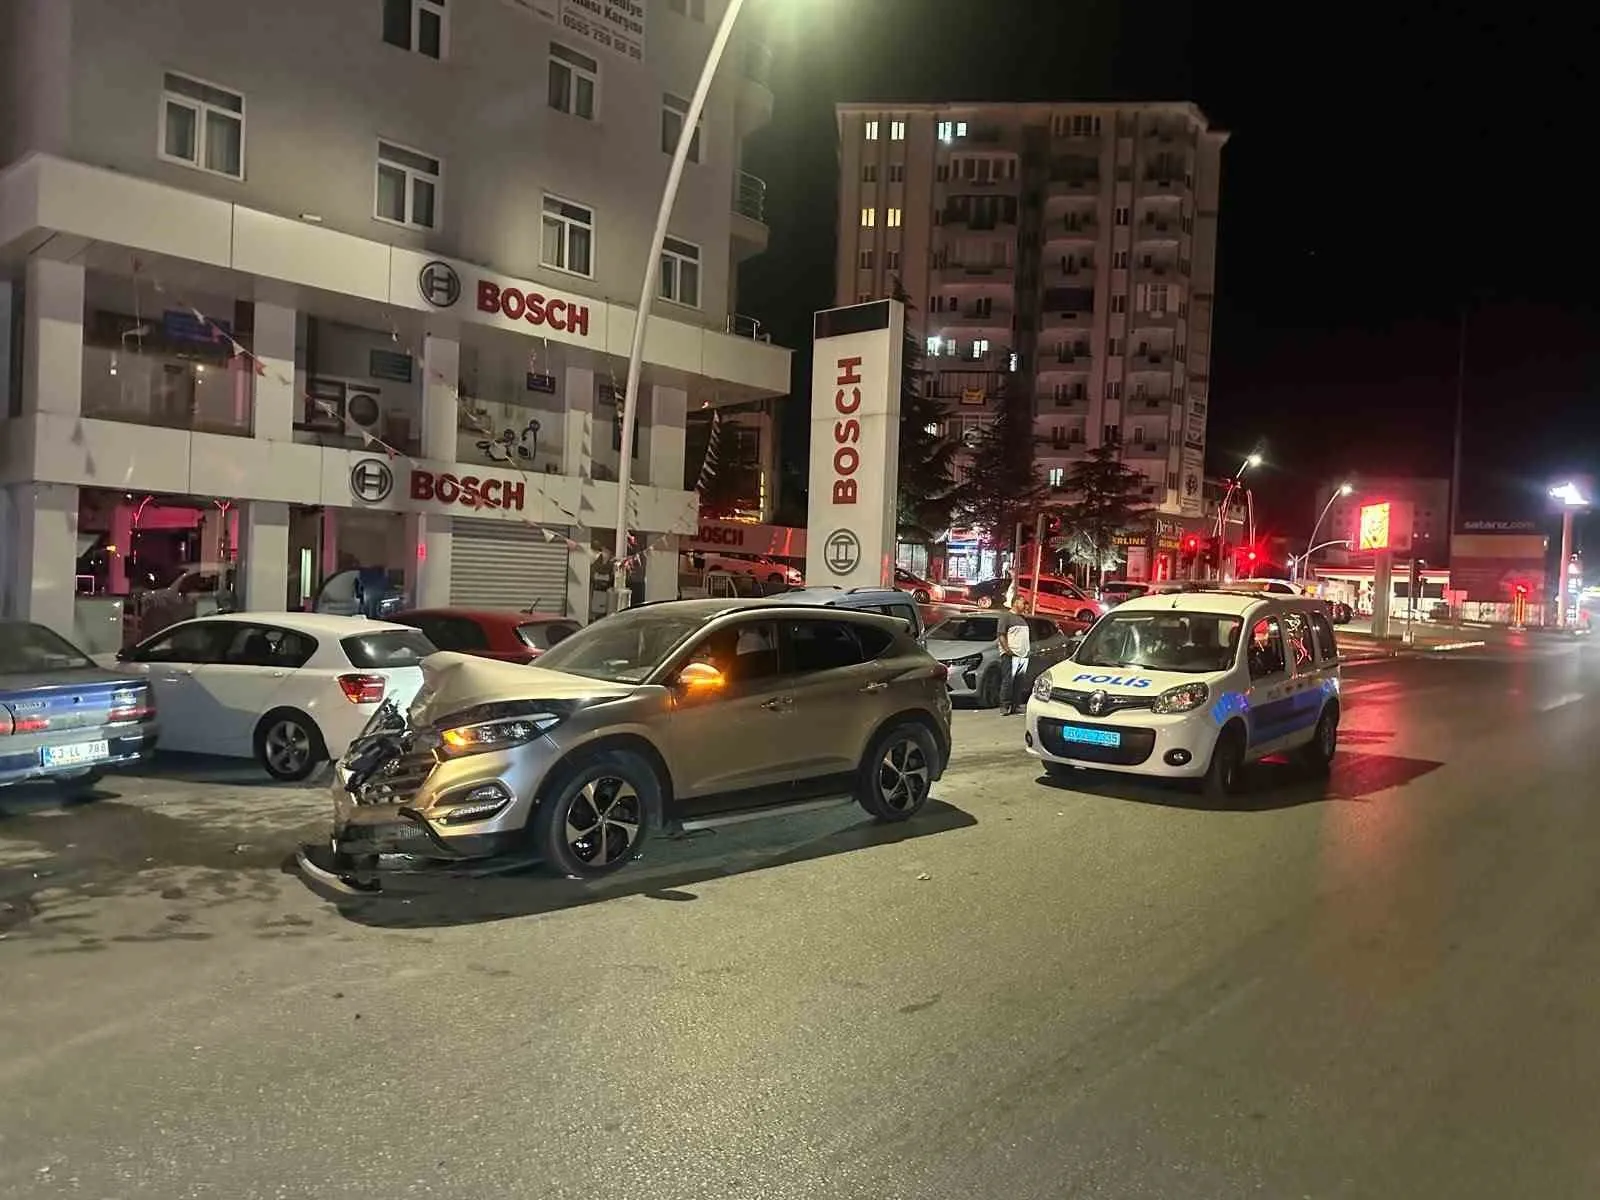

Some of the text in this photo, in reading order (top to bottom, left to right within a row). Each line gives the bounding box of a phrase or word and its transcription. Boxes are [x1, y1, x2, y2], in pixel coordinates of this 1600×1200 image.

[477, 280, 589, 336] BOSCH
[832, 356, 863, 504] BOSCH
[410, 470, 525, 511] BOSCH
